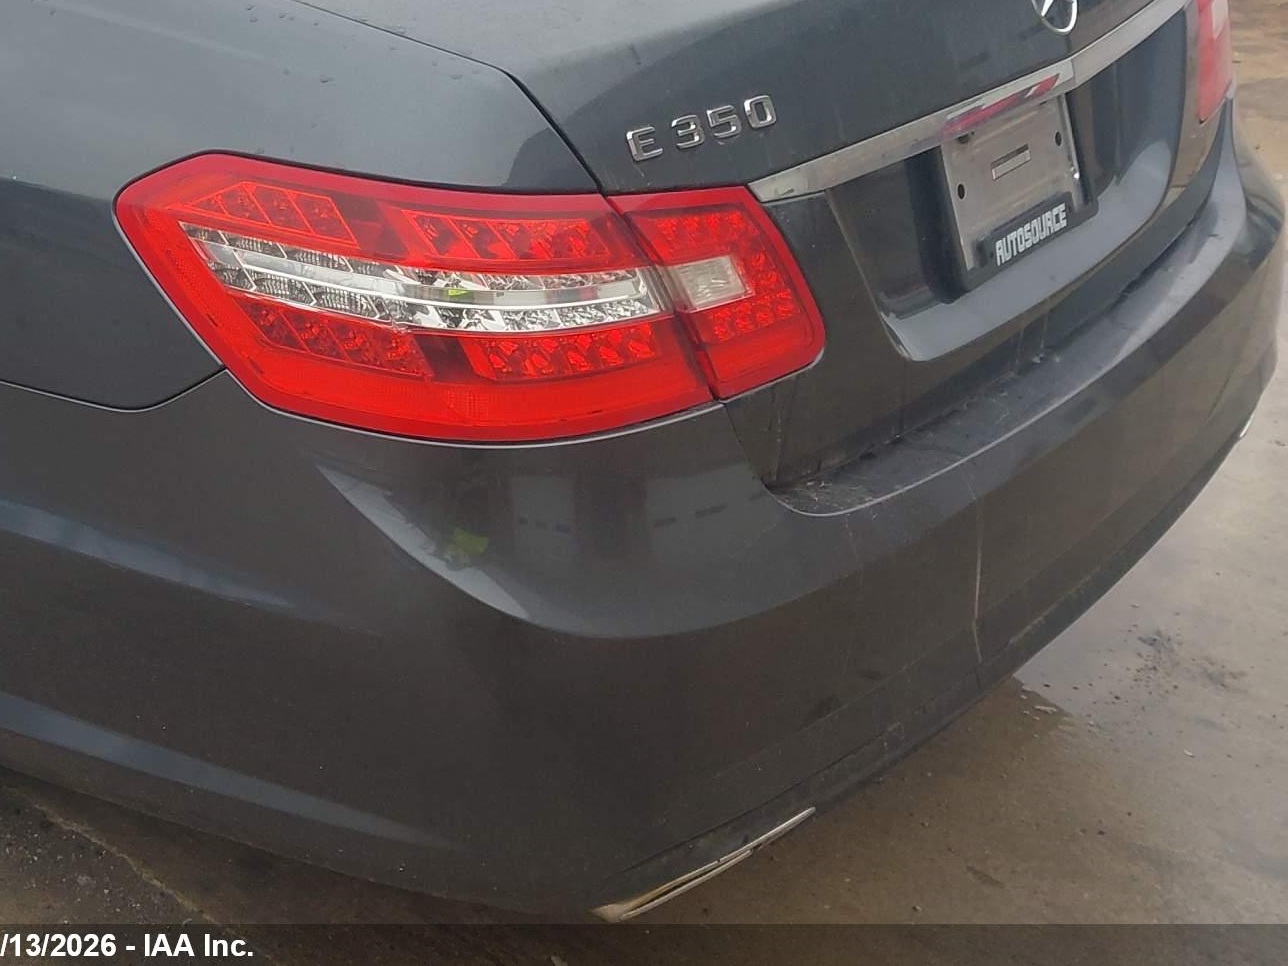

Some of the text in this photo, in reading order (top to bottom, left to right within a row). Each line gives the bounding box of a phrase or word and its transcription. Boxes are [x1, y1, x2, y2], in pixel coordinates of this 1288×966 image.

[626, 95, 777, 161] E 350
[995, 202, 1067, 266] AUTOSOURCE
